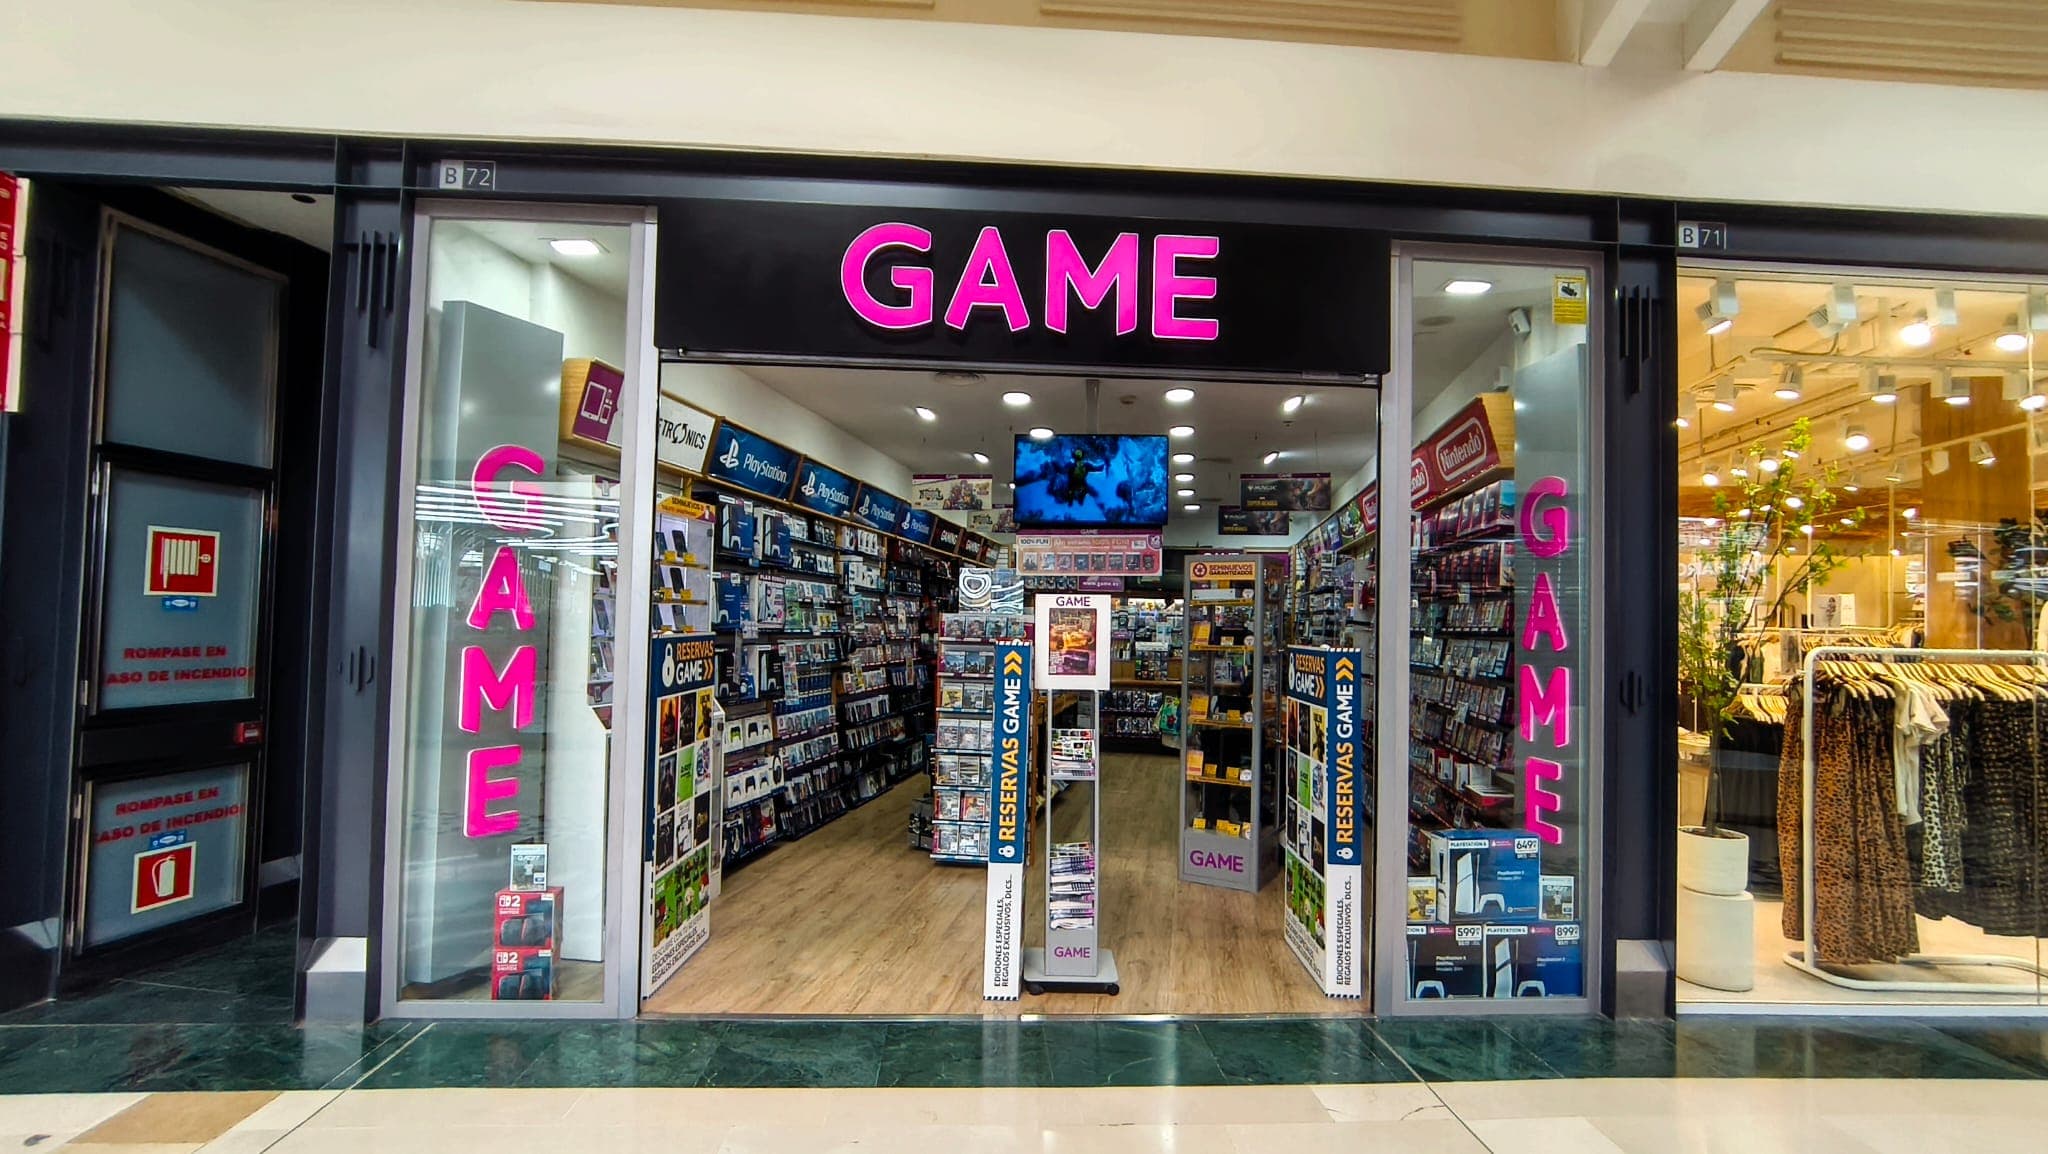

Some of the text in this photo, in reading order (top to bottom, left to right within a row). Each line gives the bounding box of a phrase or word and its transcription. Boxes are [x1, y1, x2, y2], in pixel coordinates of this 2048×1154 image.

[445, 167, 490, 186] B 72
[1683, 228, 1721, 246] B 71
[840, 221, 1221, 341] GAME
[1440, 431, 1483, 472] Nintendo
[742, 452, 788, 484] PlayStation
[817, 482, 850, 506] PlayStation
[1056, 596, 1091, 607] GAME
[123, 645, 228, 660] ROMPASE EN
[458, 443, 546, 838] GAME
[676, 640, 714, 660] RESERVAS
[676, 660, 703, 683] GAME
[1295, 653, 1325, 675] RESERVAS
[1519, 474, 1571, 845] GAME
[106, 671, 143, 686] ASO
[147, 670, 170, 682] DE
[1295, 671, 1315, 696] GAME
[999, 678, 1021, 841] RESERVAS GAME
[1335, 684, 1354, 843] RESERVAS GAME
[115, 786, 220, 816] ROMPASE EN
[140, 820, 161, 834] DE
[1189, 849, 1244, 872] GAME
[511, 895, 520, 907] 2
[509, 952, 518, 964] 2
[651, 948, 676, 974] EDICIONES
[1054, 946, 1091, 958] GAME
[1336, 944, 1344, 985] EDICIONES
[651, 959, 672, 984] REGALOS
[994, 944, 1002, 987] EDICIONES
[1002, 951, 1010, 987] REGALOS
[1344, 950, 1352, 986] REGALOS
